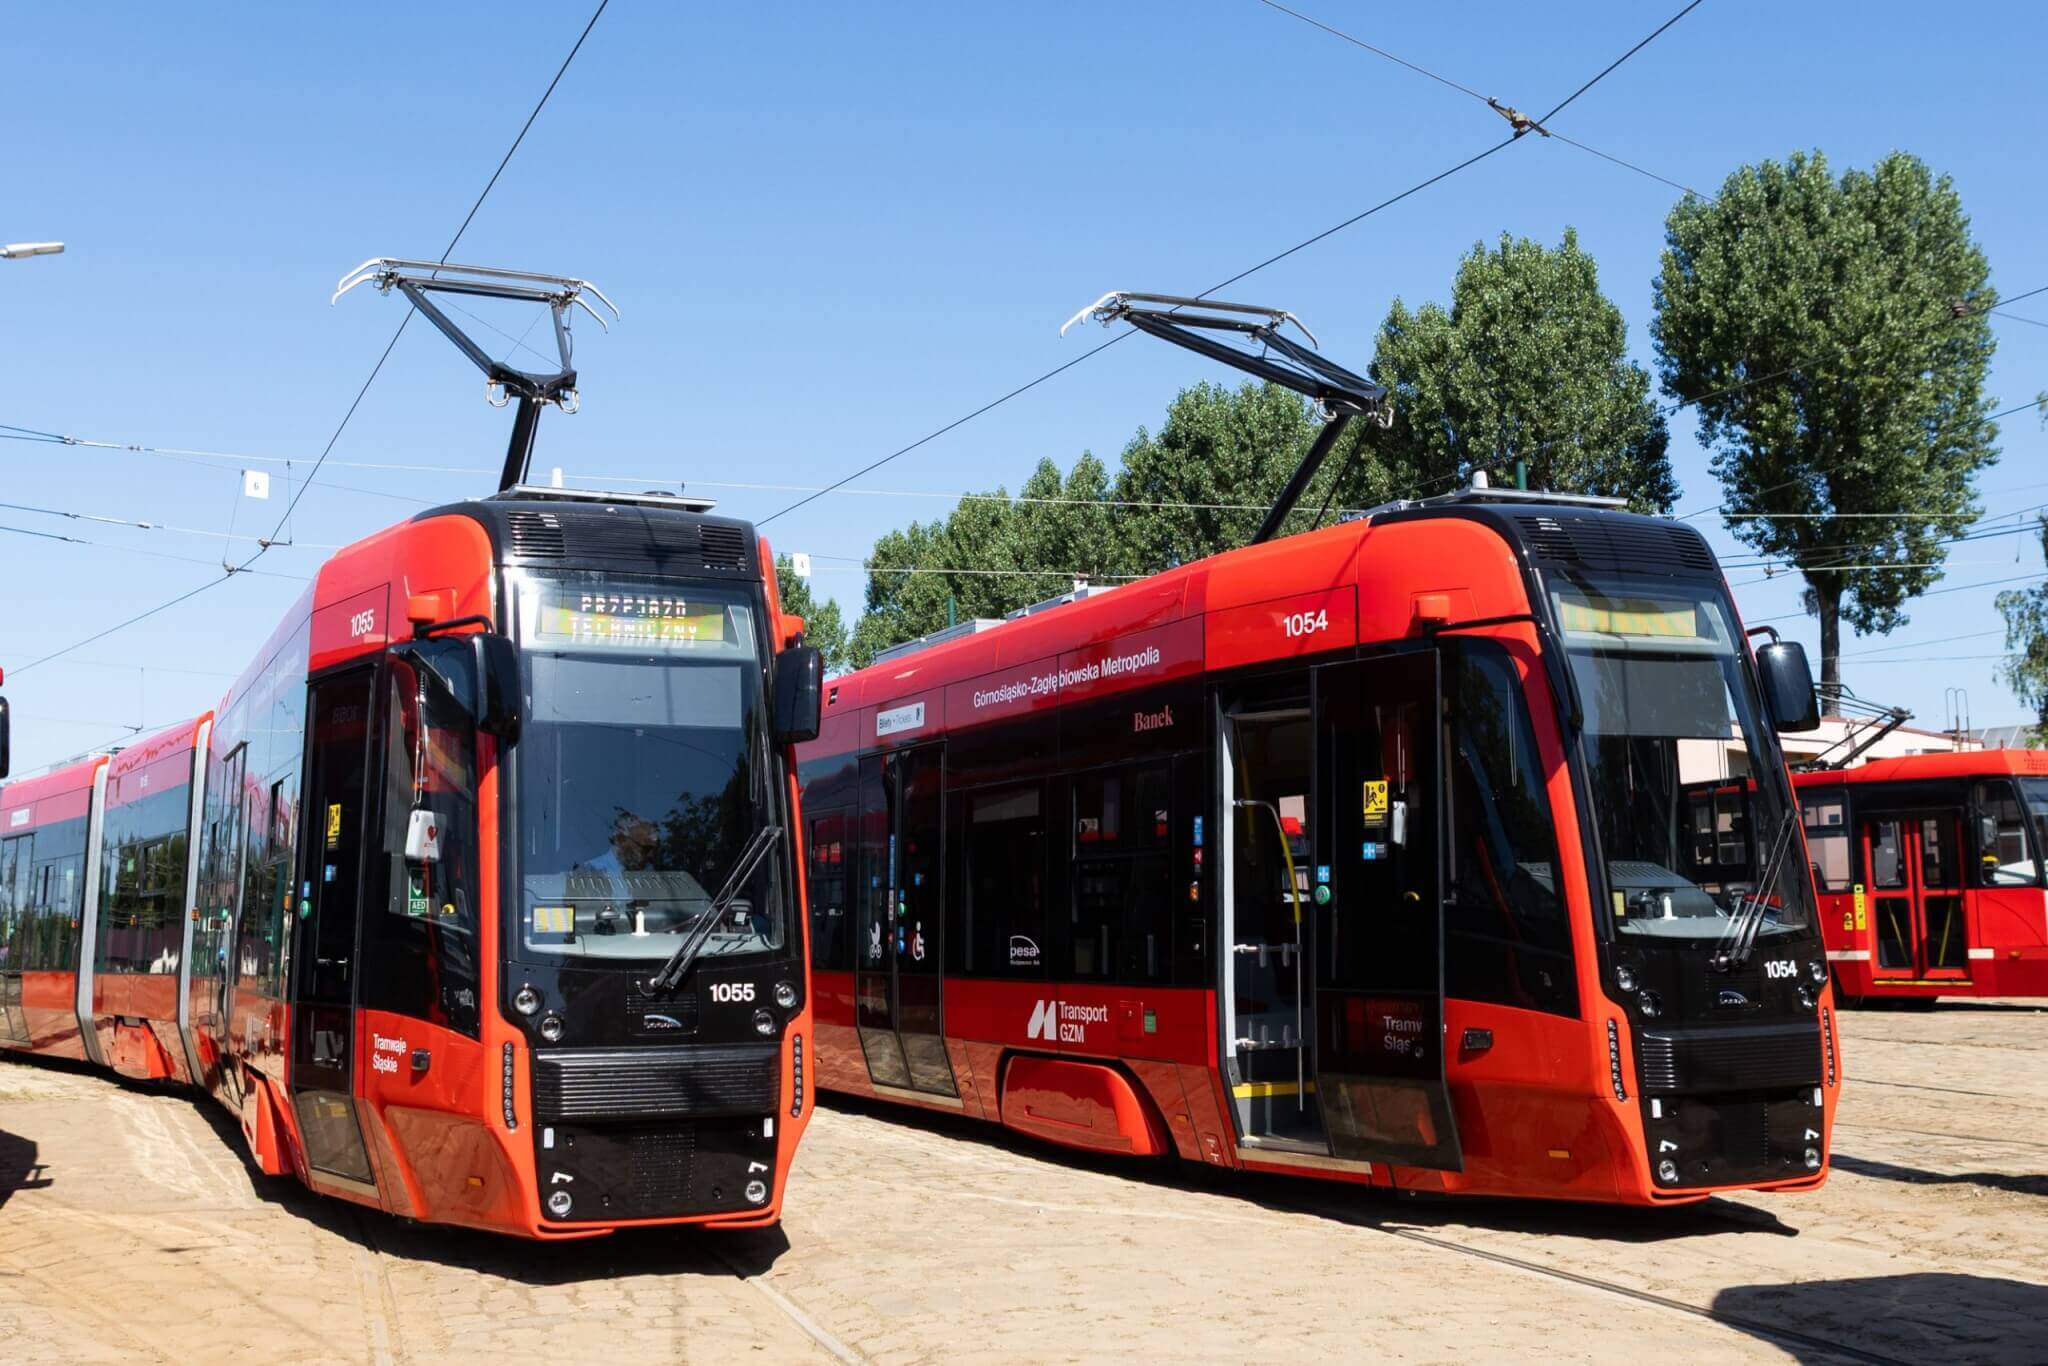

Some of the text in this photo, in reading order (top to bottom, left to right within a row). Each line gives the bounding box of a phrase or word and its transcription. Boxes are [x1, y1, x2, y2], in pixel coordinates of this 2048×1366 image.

[351, 608, 375, 637] 1055
[1283, 608, 1329, 638] 1054
[1100, 646, 1160, 678] Metropolia
[1134, 704, 1174, 732] Banek
[412, 901, 426, 910] AED
[1010, 946, 1037, 959] pesa
[1764, 959, 1798, 979] 1054
[709, 983, 755, 1002] 1055
[1058, 1001, 1108, 1024] Transport
[373, 1033, 407, 1056] Tramwaje
[1060, 1024, 1085, 1043] GZM
[373, 1051, 398, 1074] Śląskie
